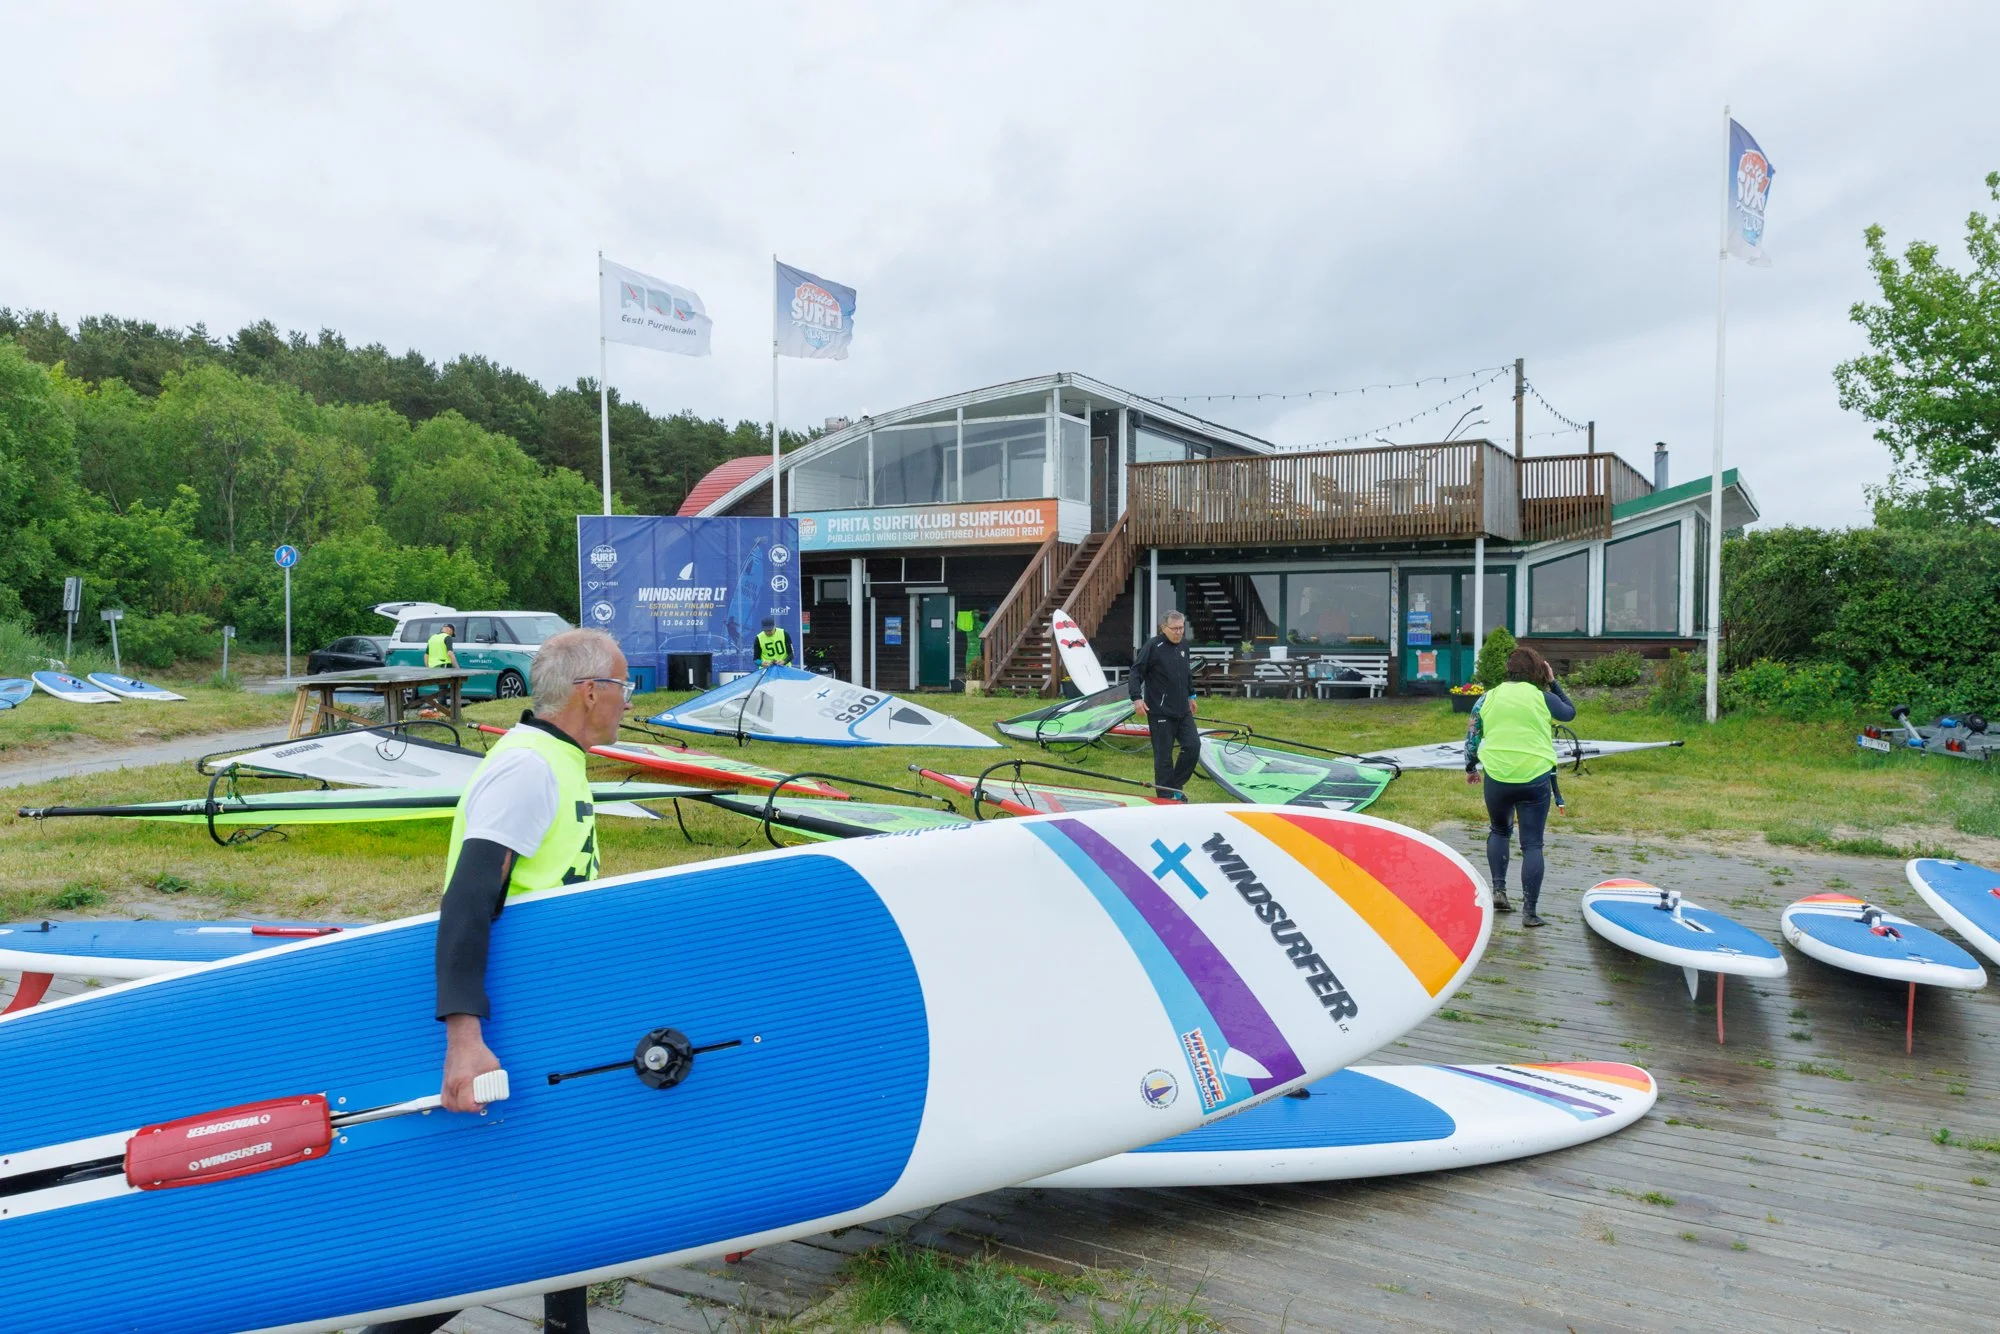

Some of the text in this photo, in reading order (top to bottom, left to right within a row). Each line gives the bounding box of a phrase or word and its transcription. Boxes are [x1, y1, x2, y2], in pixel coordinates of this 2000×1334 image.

[621, 314, 644, 325] Eesti
[828, 509, 1045, 532] PIRITA SURFIKLUBI SURFIKOOL
[827, 526, 1045, 543] PURJELAUD WING SUP KOOLITUSED LAAGRID RENT
[638, 587, 712, 602] WINDSURFER
[713, 587, 728, 601] LT
[764, 640, 785, 657] 50
[1201, 832, 1358, 1023] WINDSURFER
[1182, 1033, 1214, 1108] WINDSURF.COM
[1189, 1029, 1225, 1102] VINTAGE
[1495, 1066, 1622, 1101] WINDSURFER
[1238, 1100, 1260, 1113] Group
[186, 1116, 260, 1138] WINDSURFER
[199, 1142, 272, 1168] WINDSURFER
